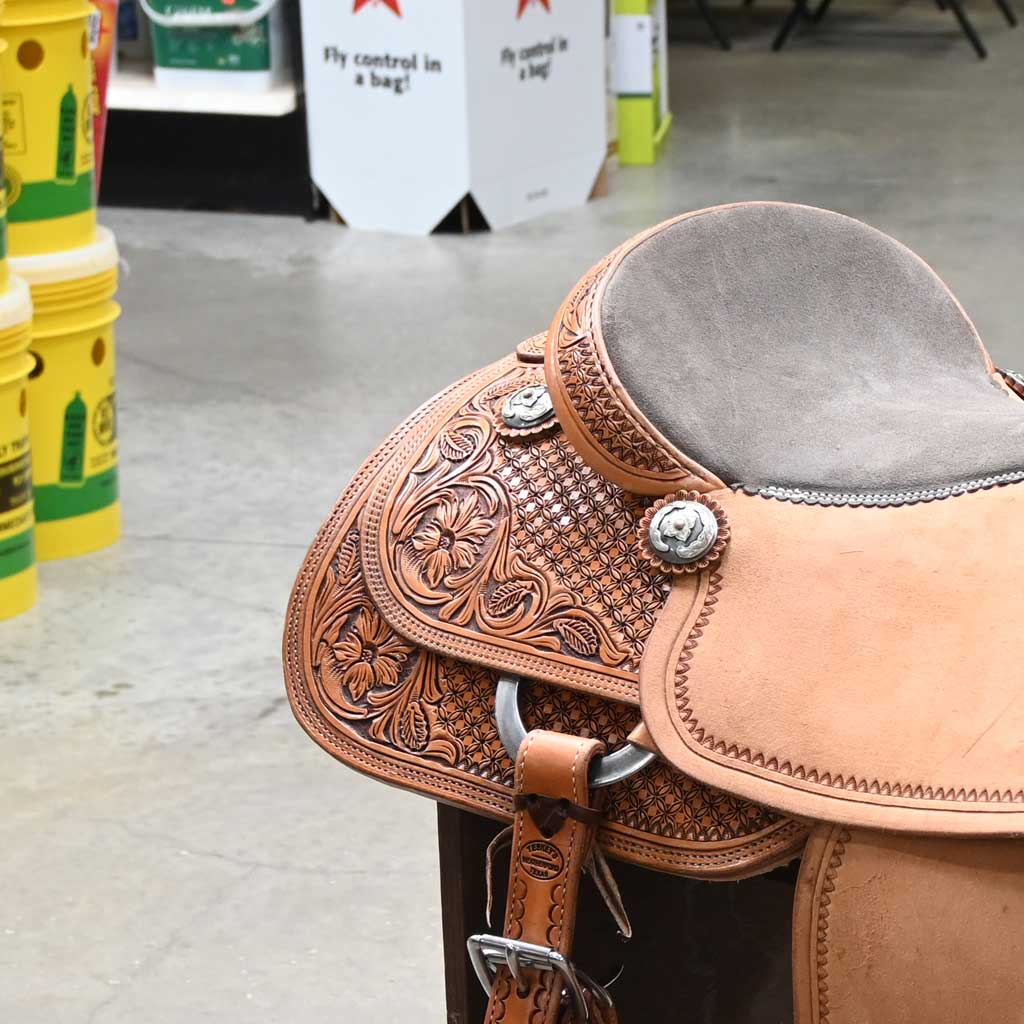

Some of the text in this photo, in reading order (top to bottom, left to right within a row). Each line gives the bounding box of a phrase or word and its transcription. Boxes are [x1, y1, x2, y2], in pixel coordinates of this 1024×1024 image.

[324, 45, 442, 72] Fly control in
[355, 71, 410, 94] a bag!
